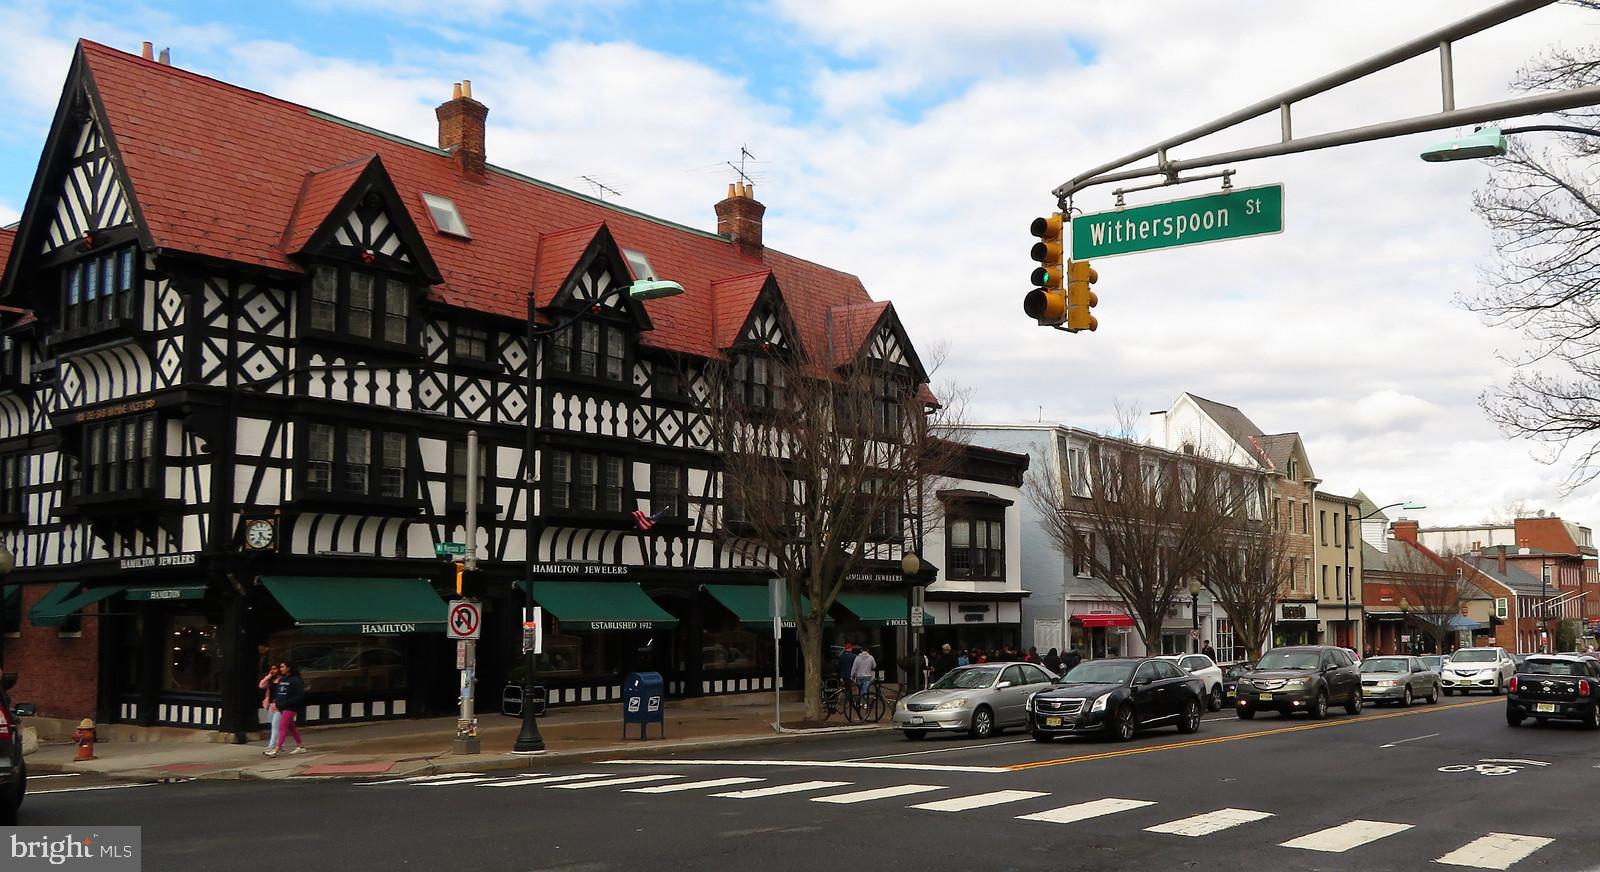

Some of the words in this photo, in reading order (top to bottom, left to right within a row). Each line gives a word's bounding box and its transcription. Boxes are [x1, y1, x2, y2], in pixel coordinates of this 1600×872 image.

[1090, 207, 1229, 246] Witherspoon
[1246, 198, 1262, 215] St
[120, 557, 156, 569] HAMILTON
[159, 554, 196, 566] JEWELERS
[532, 564, 580, 574] HAMILTON
[584, 565, 628, 575] JEWELERS
[845, 574, 873, 582] AMILTON
[874, 574, 903, 582] JEWELERS
[150, 590, 181, 600] HAMILTON
[361, 623, 416, 634] HAMILTON
[591, 621, 637, 630] ESTABLISHED
